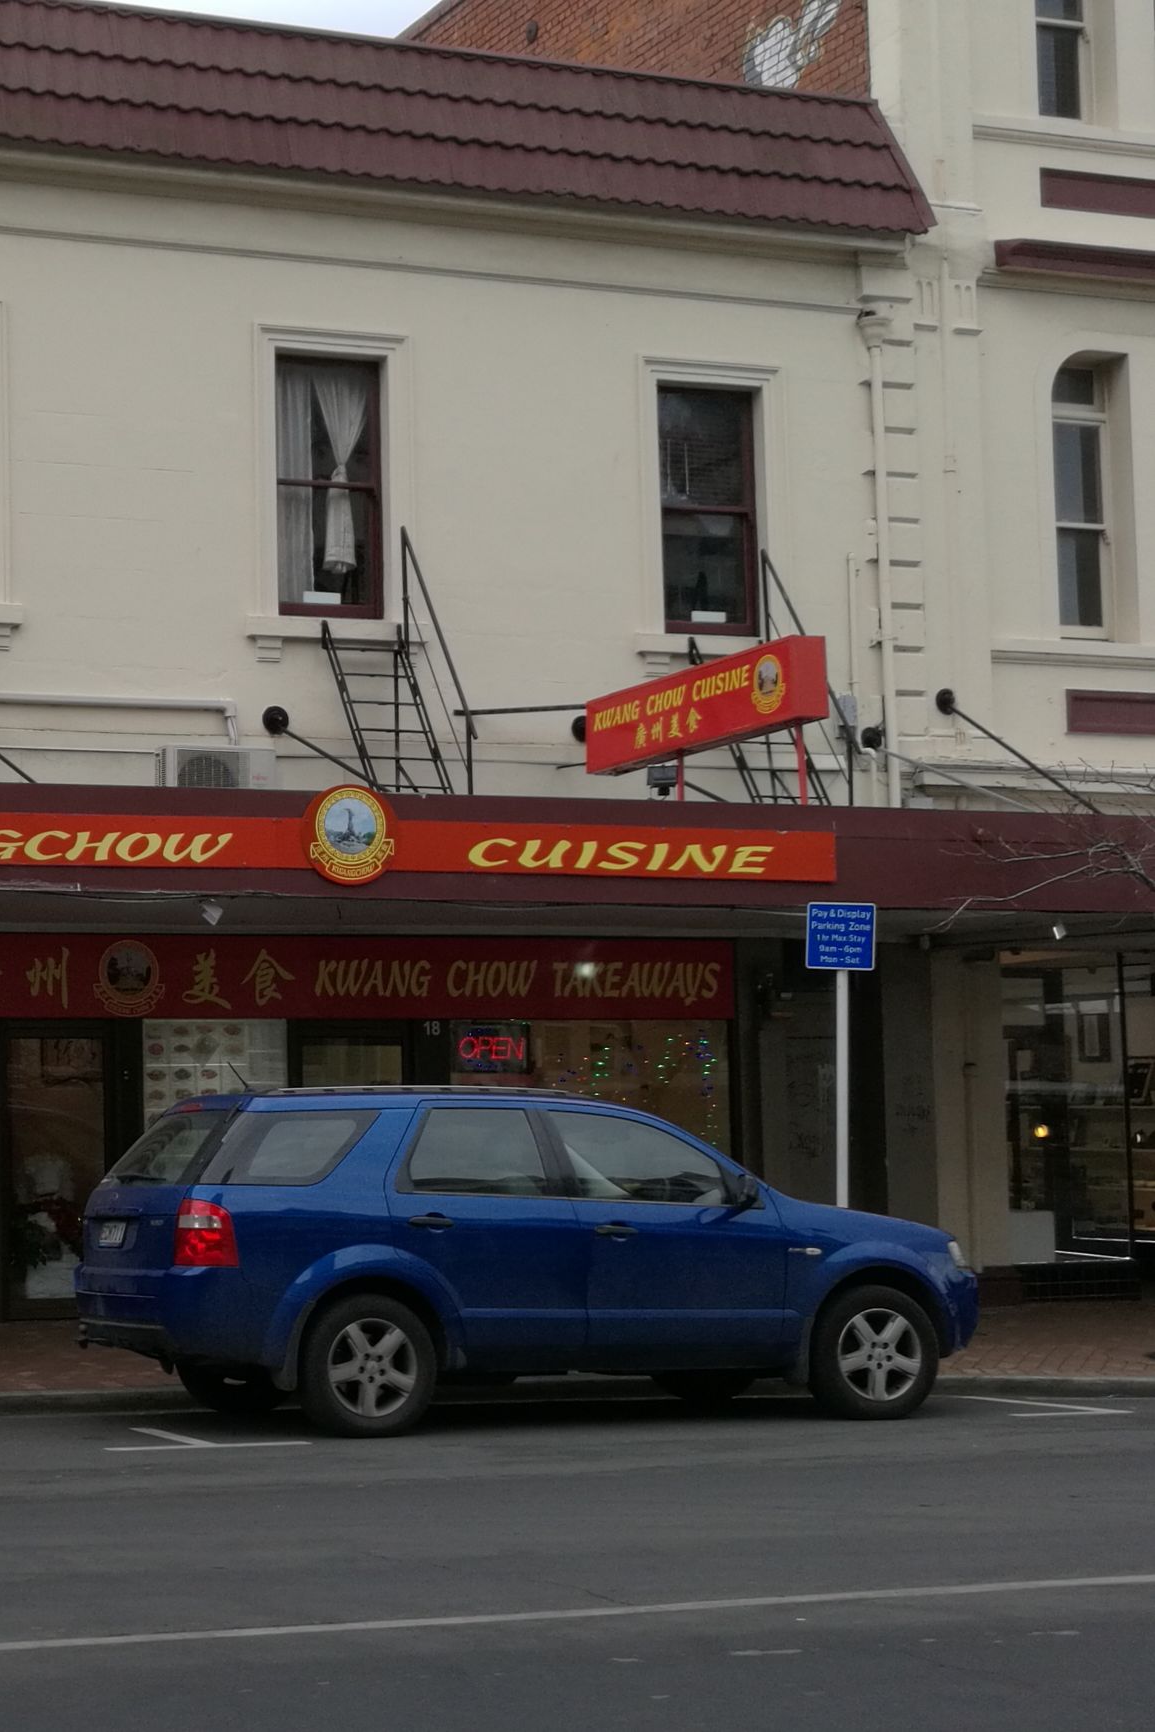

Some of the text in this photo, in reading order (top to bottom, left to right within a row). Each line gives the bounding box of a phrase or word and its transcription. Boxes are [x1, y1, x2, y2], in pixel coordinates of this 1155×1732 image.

[593, 664, 752, 731] KWANG CHOW CUISINE
[468, 838, 773, 874] CUISINE
[811, 908, 872, 921] Pay & Display
[811, 921, 871, 932] Parking Zone
[831, 934, 847, 942] Max
[848, 934, 866, 944] Stay
[818, 944, 837, 953] 9am
[843, 944, 862, 954] 6pm
[819, 955, 838, 963] Mon
[845, 955, 860, 964] Sat
[181, 948, 296, 1010] 美食
[314, 959, 722, 1006] KWANG CHOW TAKEAWAYS
[423, 1020, 442, 1036] 18
[457, 1035, 527, 1060] OPEN
